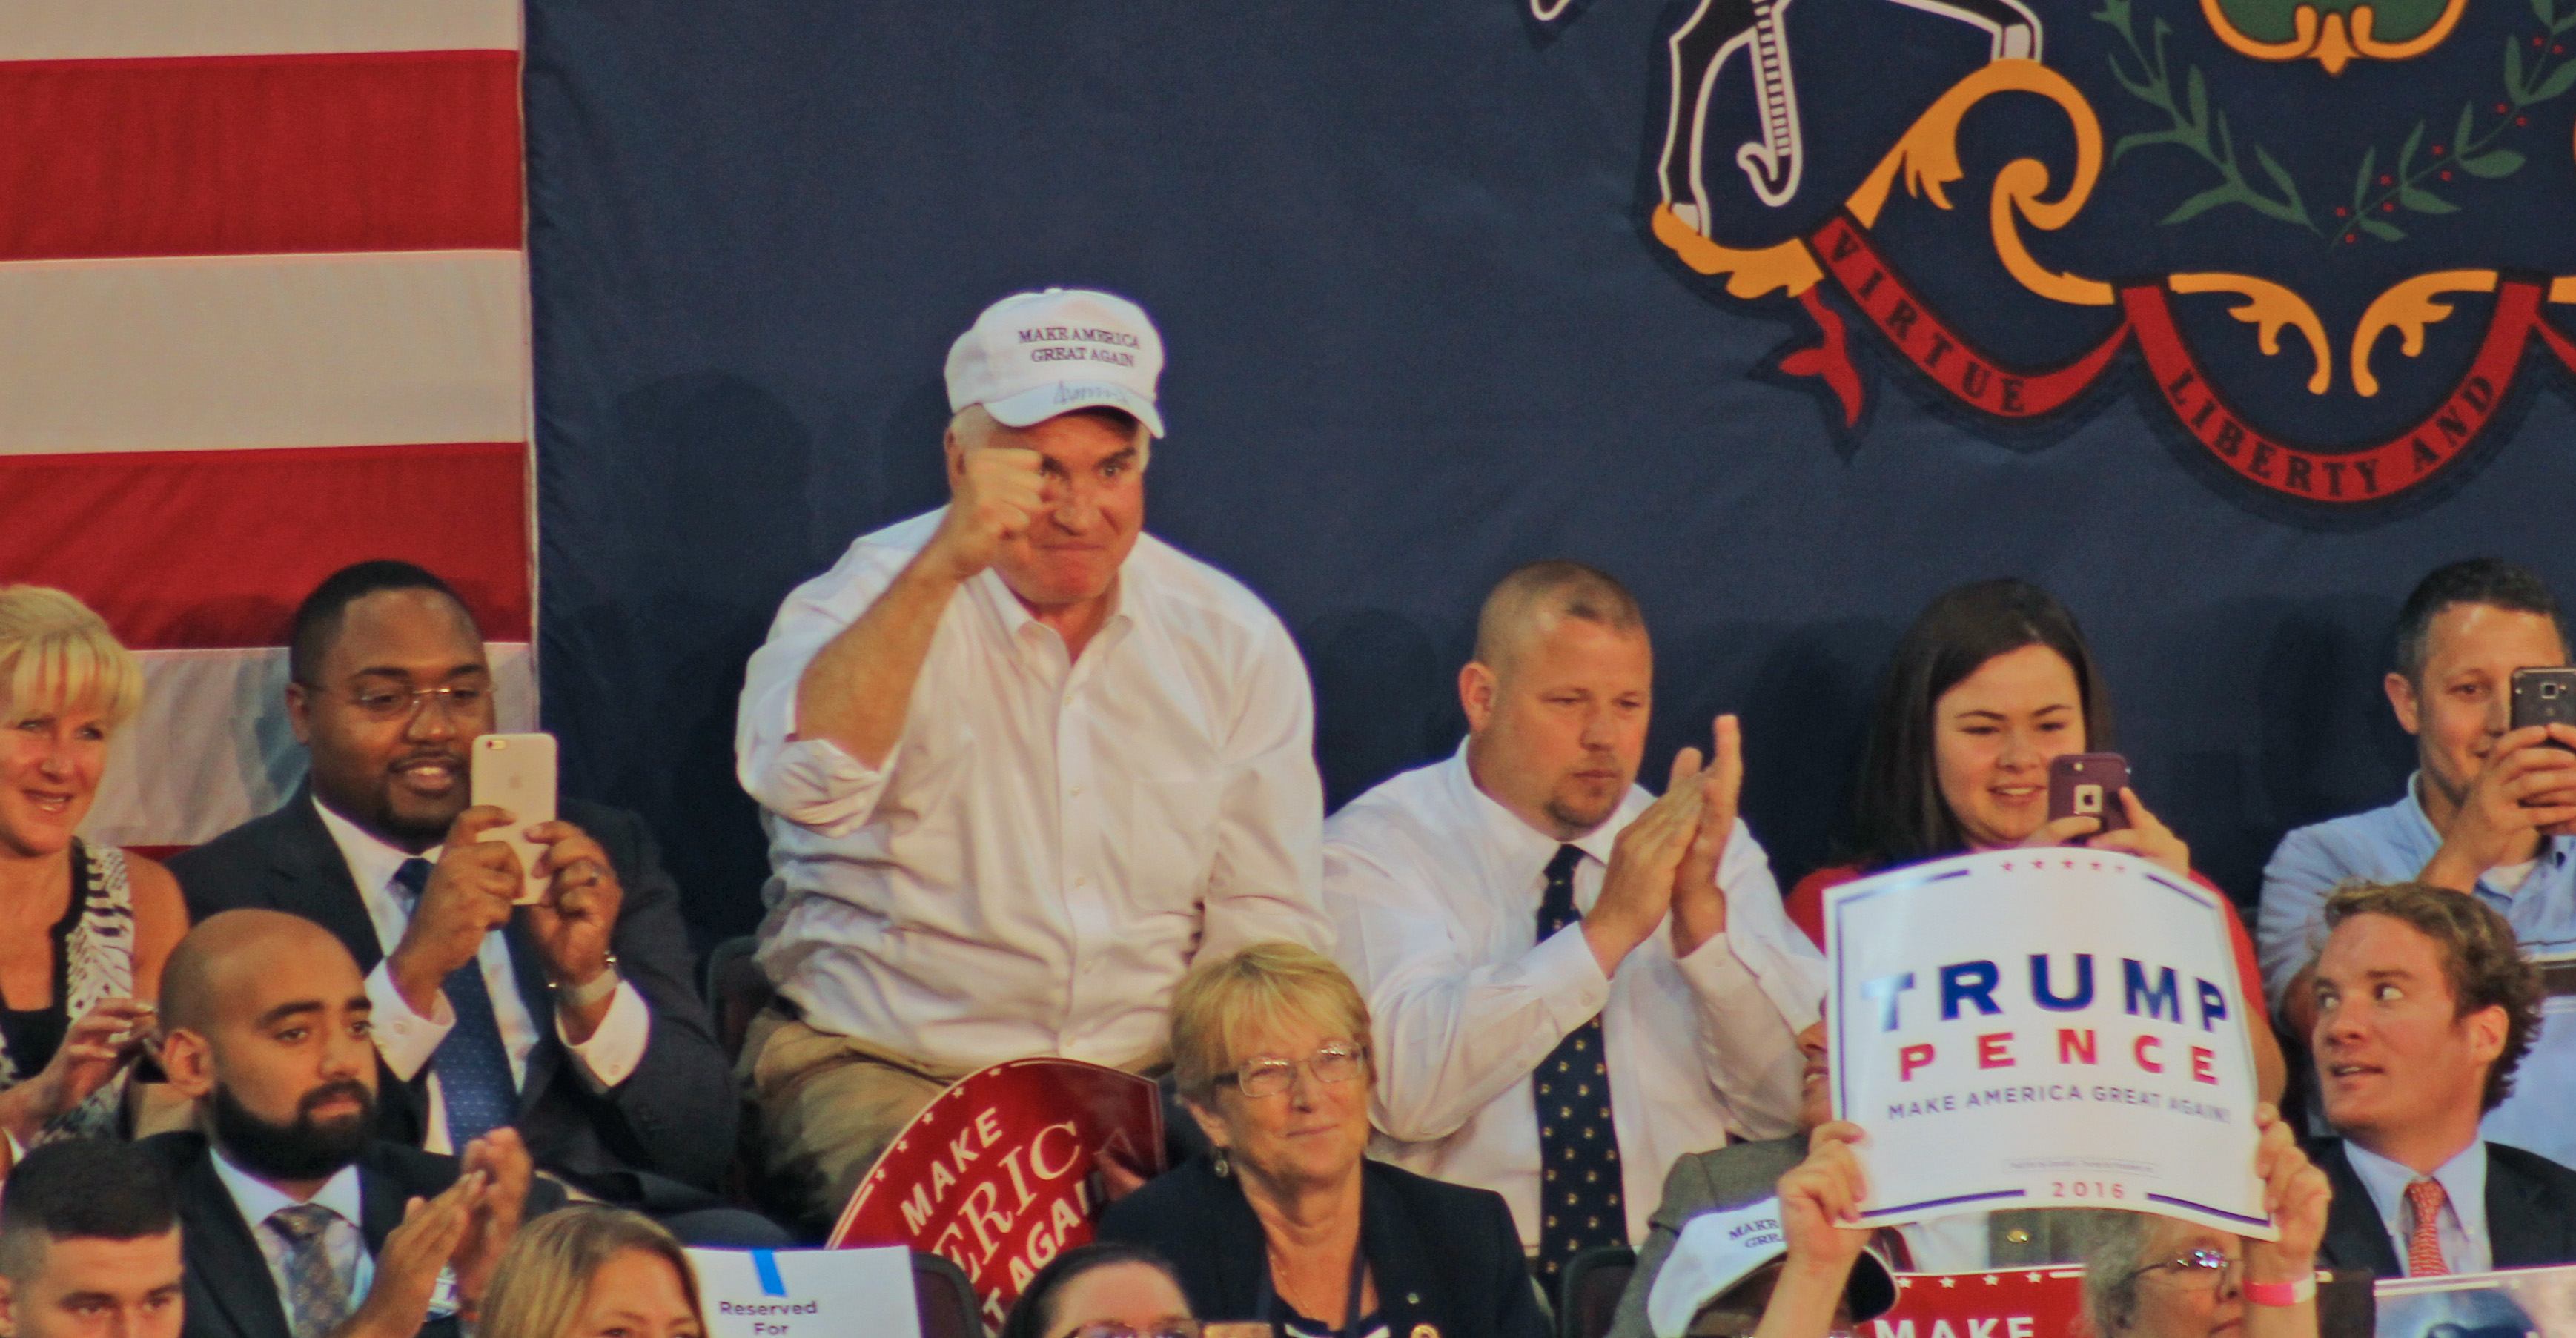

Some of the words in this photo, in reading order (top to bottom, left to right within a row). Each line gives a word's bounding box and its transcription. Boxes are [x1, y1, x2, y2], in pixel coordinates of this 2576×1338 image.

[1831, 230, 2026, 413] VIRTUE
[1018, 327, 1069, 343] MAKE
[1073, 328, 1140, 350] AMERICA
[1031, 347, 1086, 362] GREAT
[1090, 349, 1136, 367] AGAIN
[2168, 369, 2378, 497] LIBERTY
[2411, 377, 2494, 473] AND
[1860, 952, 2229, 1032] TRUMP
[1898, 1028, 2219, 1085] PENCE
[1888, 1095, 1956, 1120] MAKE
[1965, 1084, 2084, 1108] AMERICA
[2091, 1085, 2161, 1108] GREAT
[900, 1107, 1003, 1237] MAKE
[2051, 1181, 2125, 1199] 2016
[1008, 1169, 1105, 1295] AGAI
[1729, 1219, 1780, 1240] MAKE
[718, 1300, 818, 1315] Reserved
[754, 1322, 788, 1335] For
[1873, 1317, 2034, 1338] MAKE
